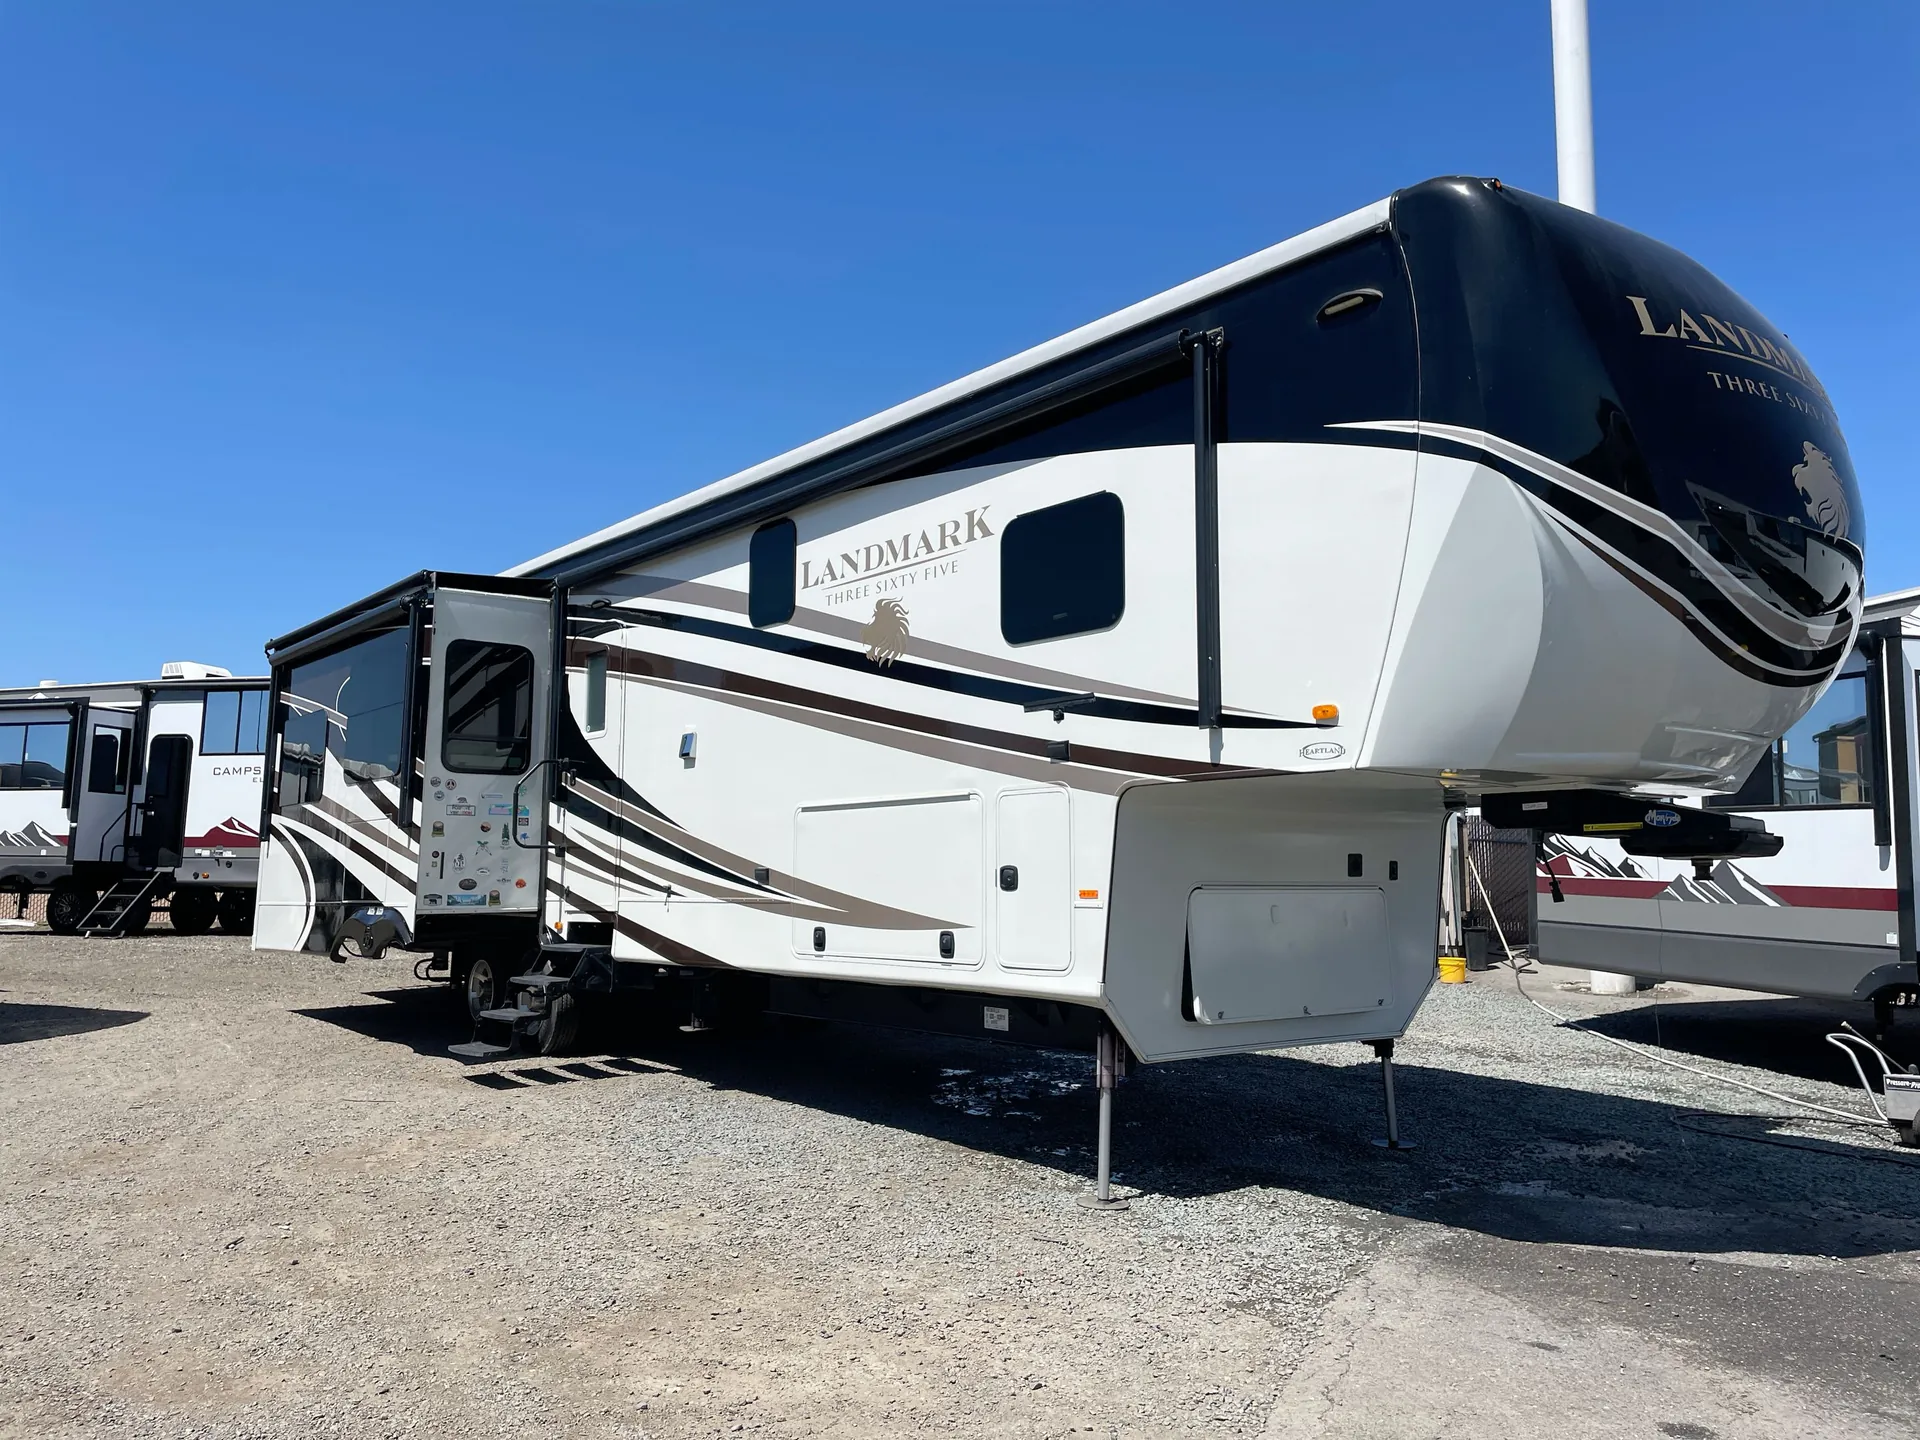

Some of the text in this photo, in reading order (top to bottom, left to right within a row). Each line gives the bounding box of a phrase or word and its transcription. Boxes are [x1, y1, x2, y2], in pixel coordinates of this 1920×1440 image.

[1626, 295, 1831, 403] LANDM
[1706, 371, 1783, 402] THREE
[801, 504, 995, 590] LANDMARK
[825, 559, 959, 607] THREE SIXTY FIVE
[1299, 746, 1346, 758] HEARTLAND
